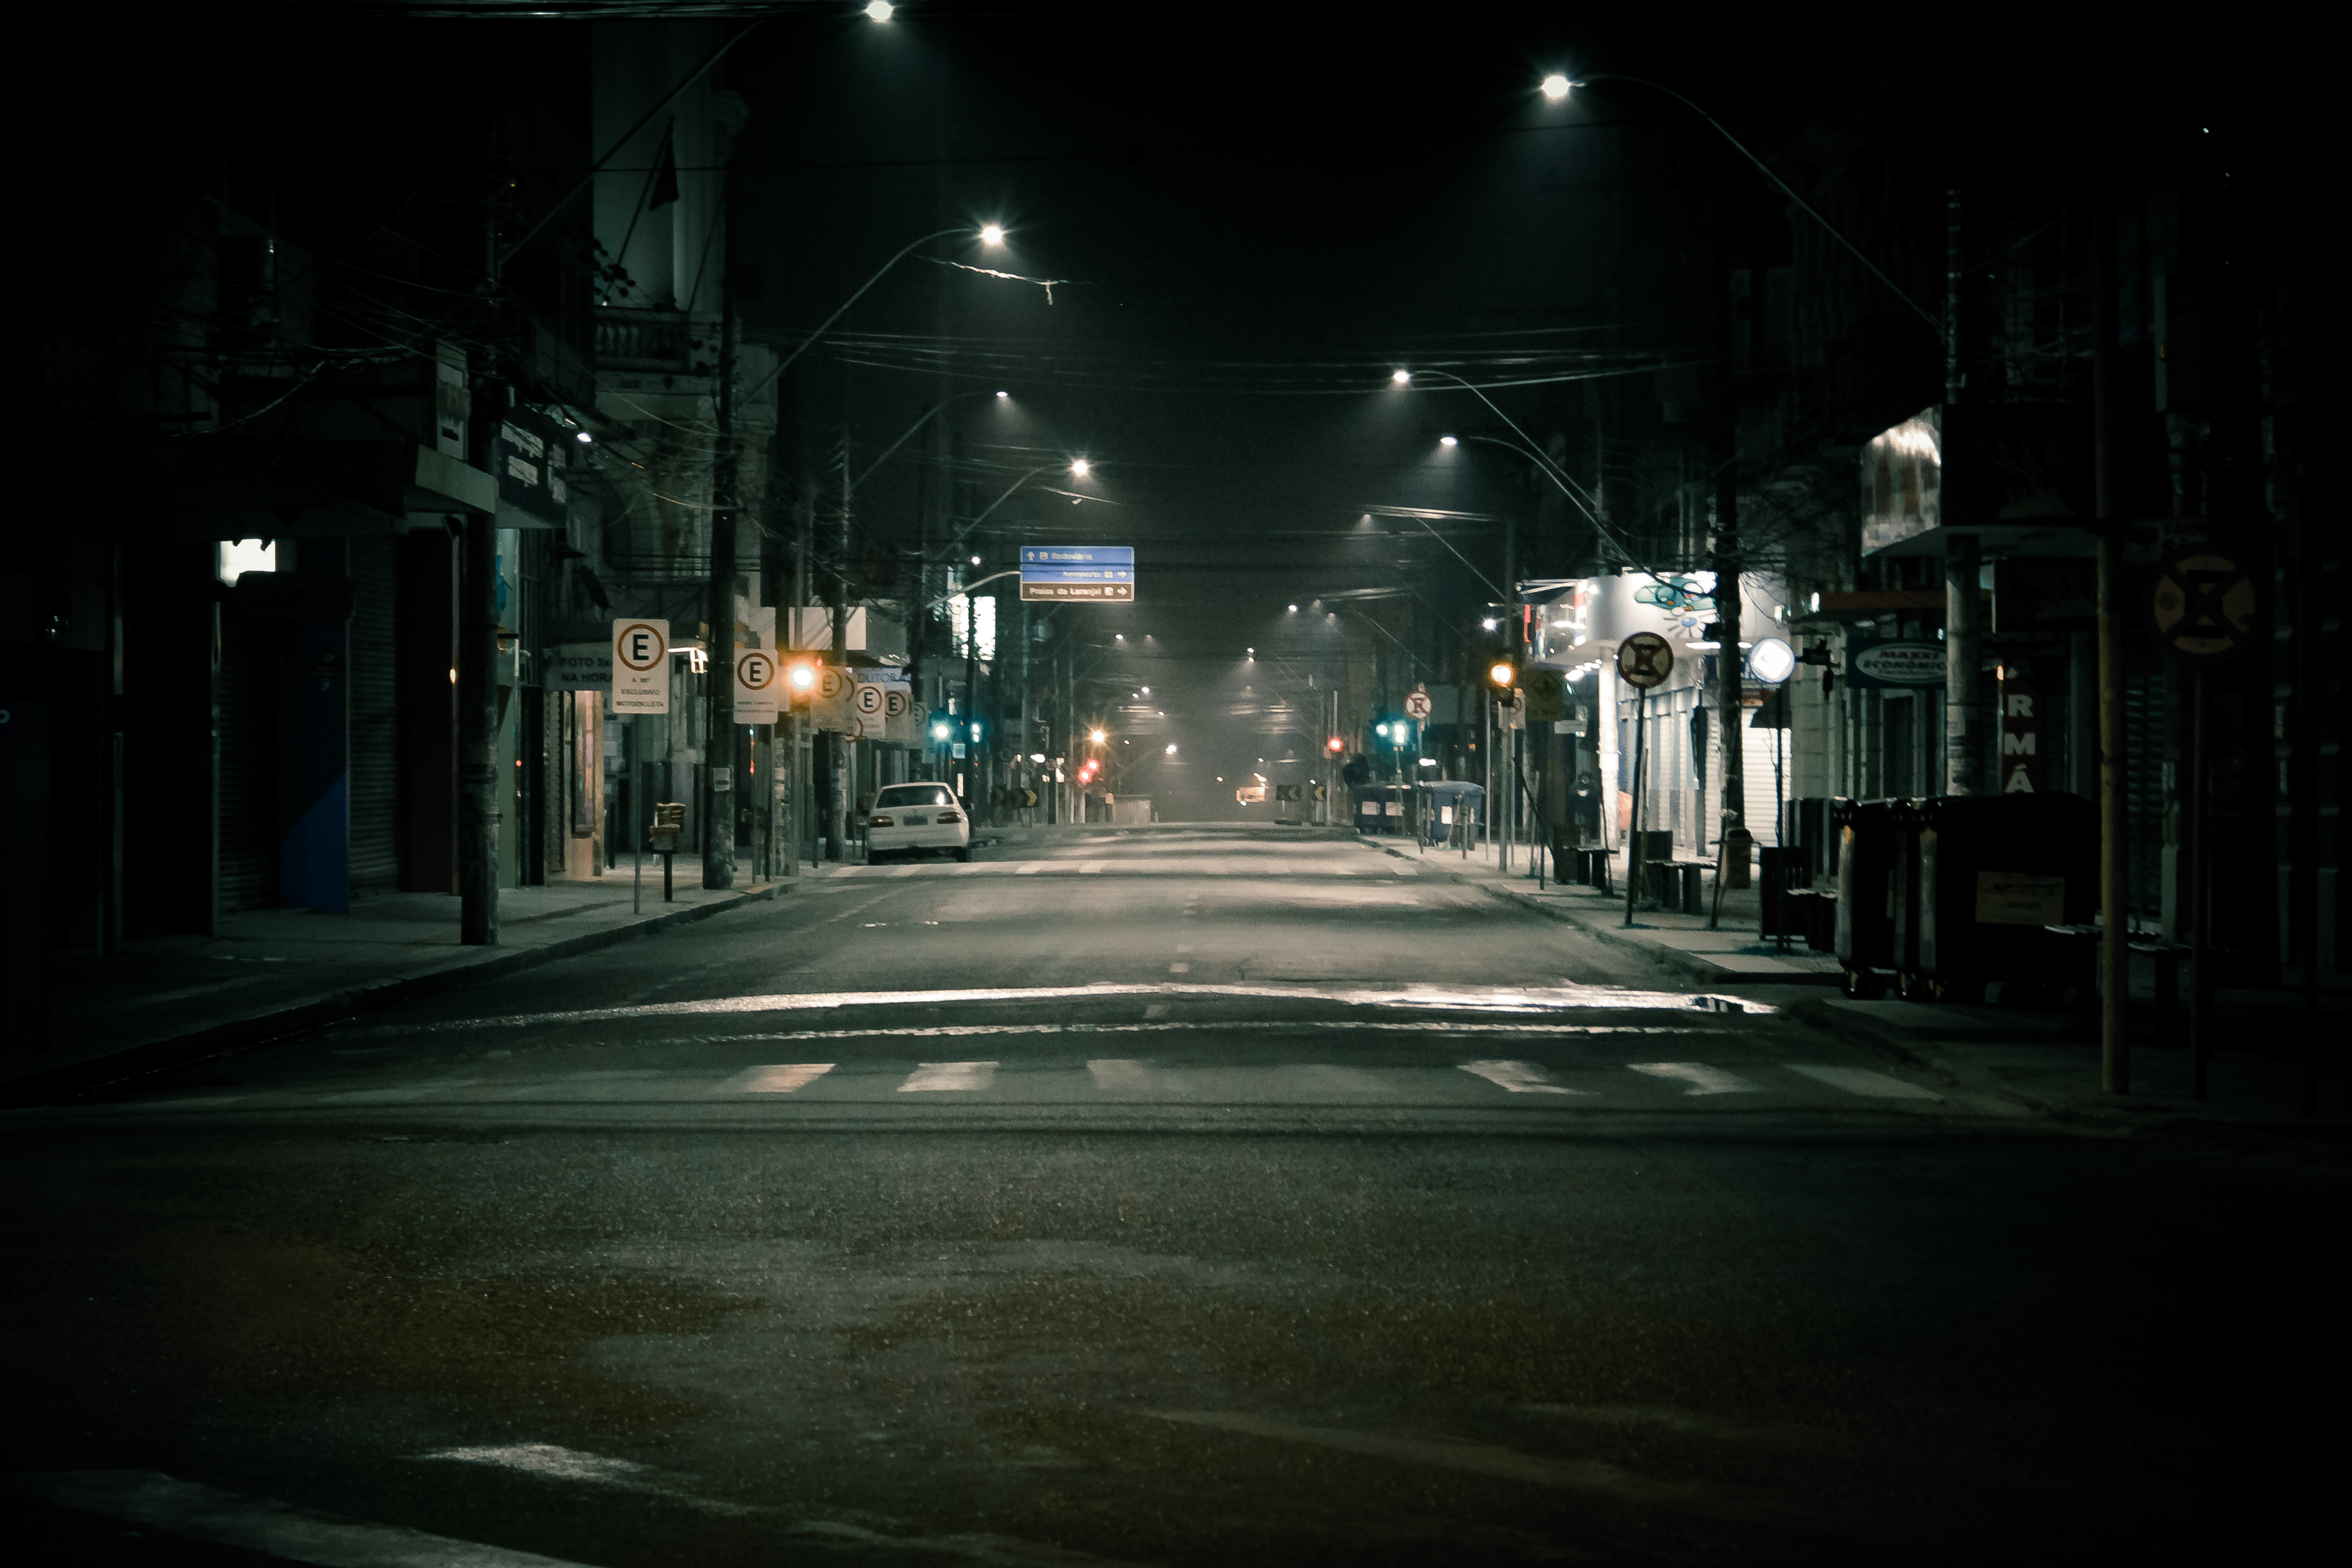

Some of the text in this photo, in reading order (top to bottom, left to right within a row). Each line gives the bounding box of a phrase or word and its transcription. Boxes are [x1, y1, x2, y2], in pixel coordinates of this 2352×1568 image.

[633, 634, 649, 660] E
[750, 662, 762, 682] E
[864, 692, 873, 707] E
[888, 697, 898, 711] E
